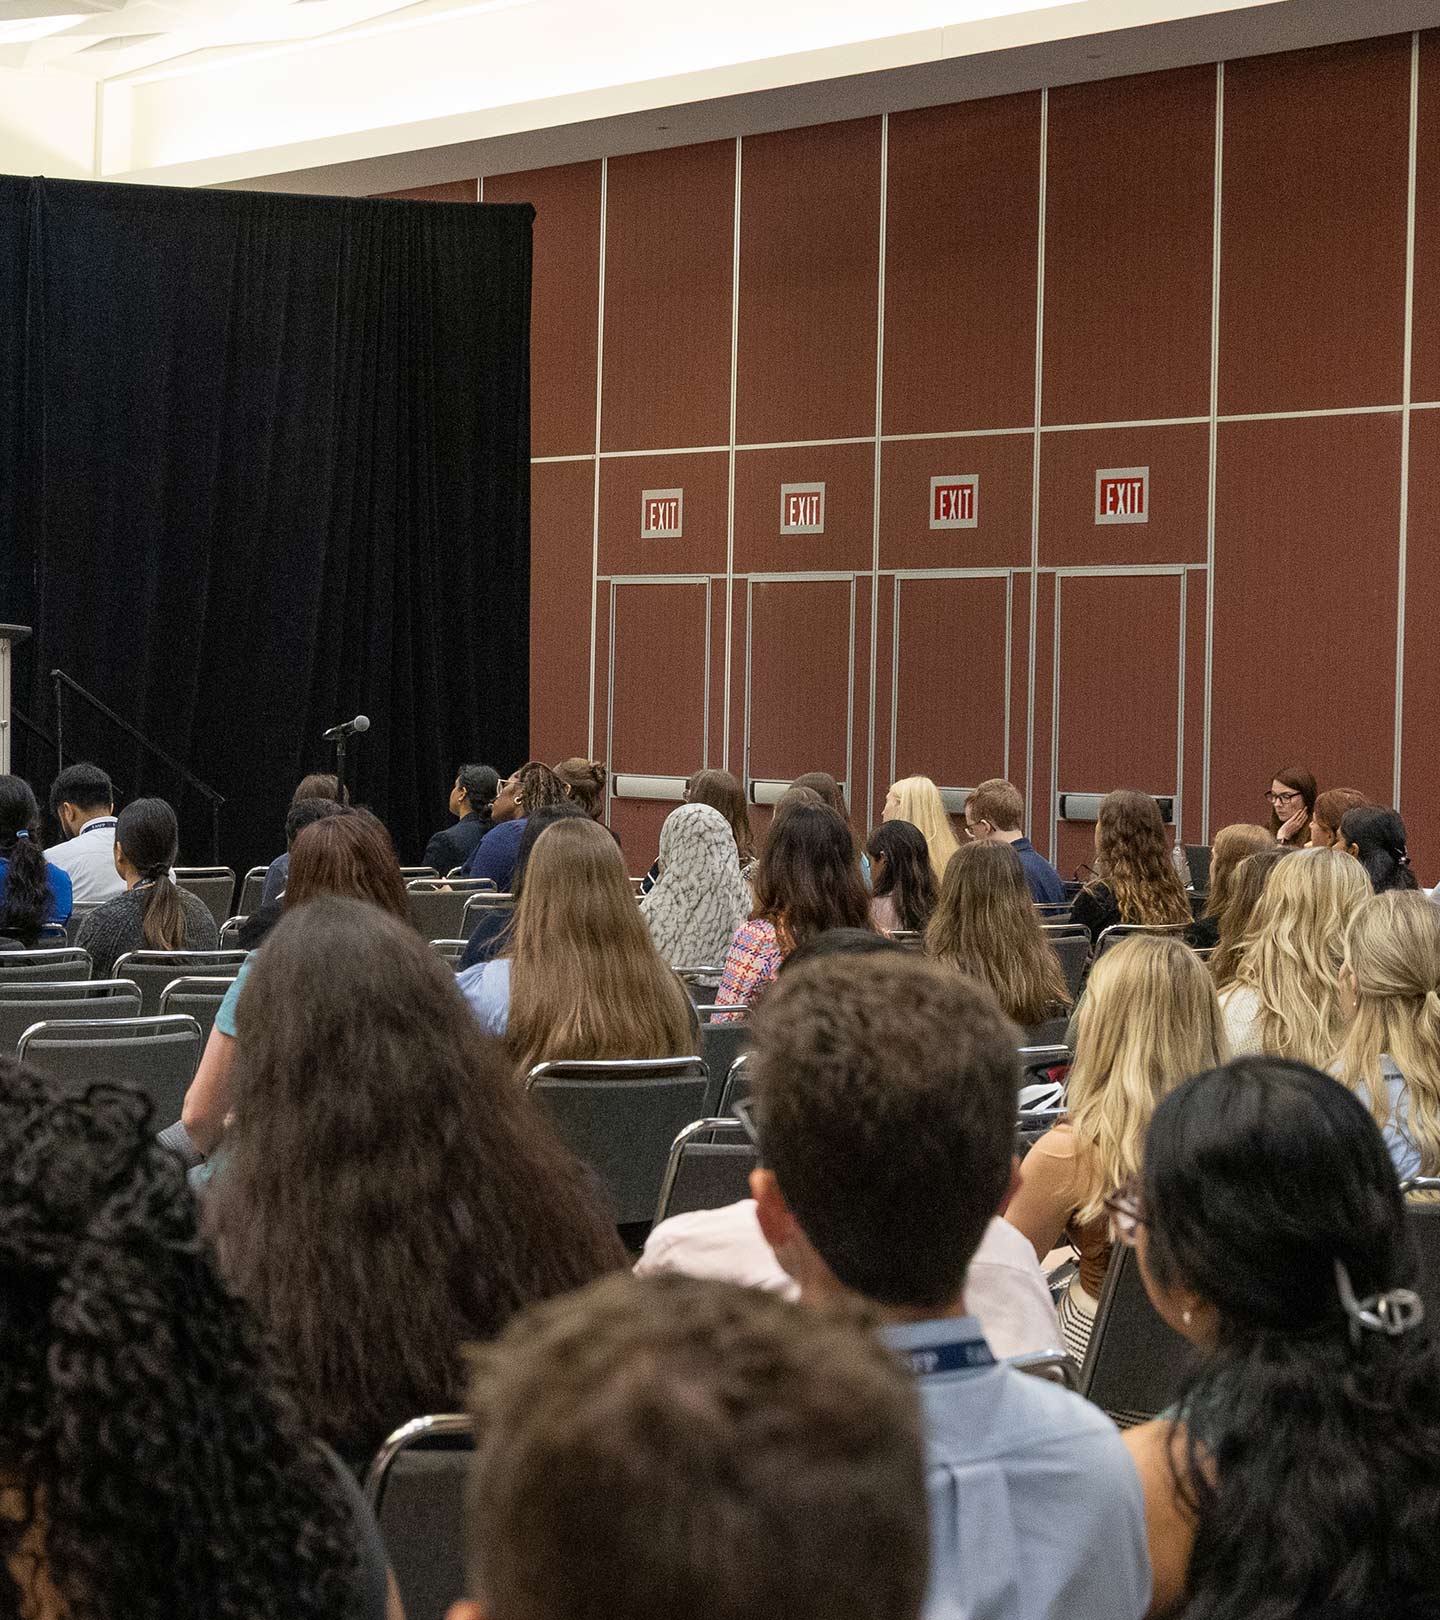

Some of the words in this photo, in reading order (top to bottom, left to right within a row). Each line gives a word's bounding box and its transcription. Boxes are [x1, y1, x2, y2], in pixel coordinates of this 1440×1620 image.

[790, 497, 819, 526] EXIT
[940, 490, 971, 521] EXIT
[1107, 483, 1141, 515] EXIT
[650, 502, 676, 531] EXIT
